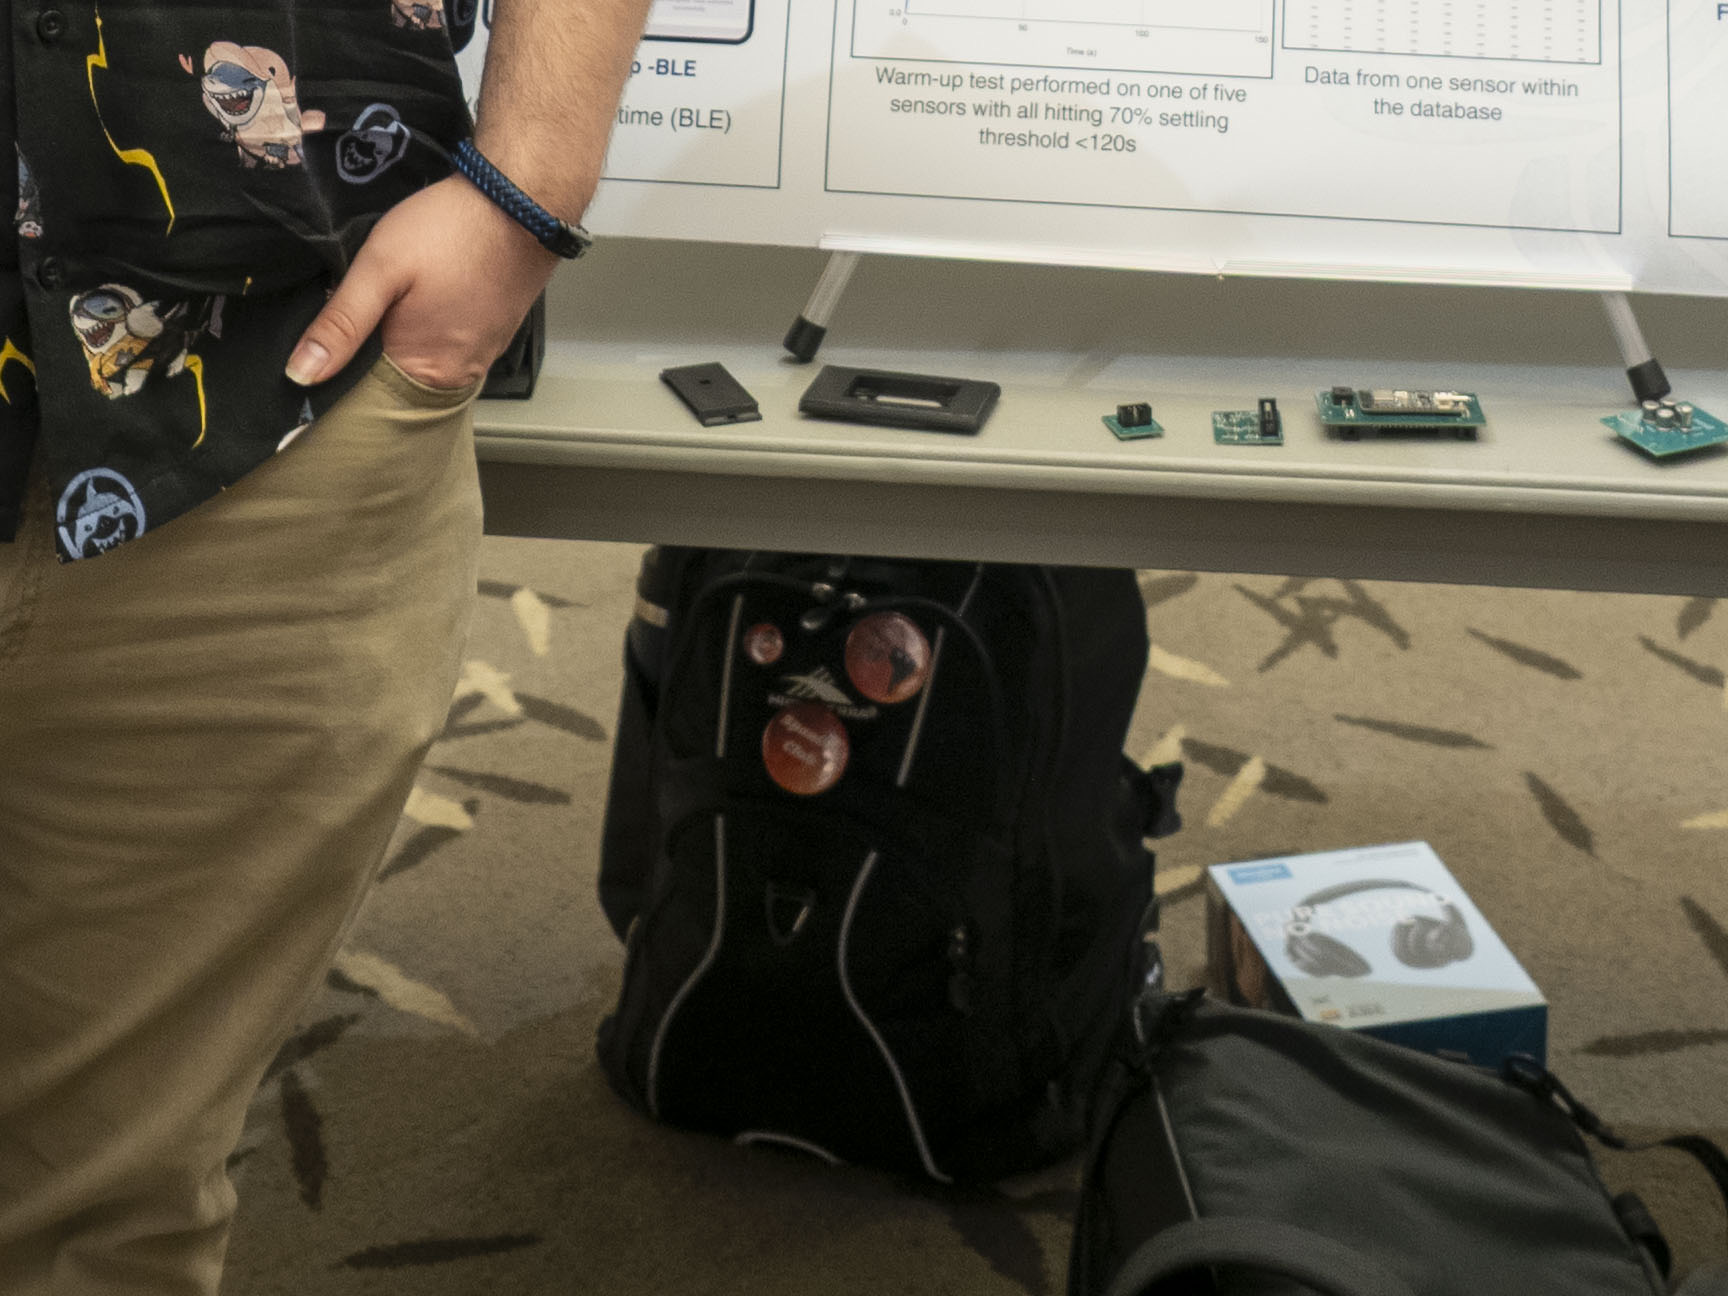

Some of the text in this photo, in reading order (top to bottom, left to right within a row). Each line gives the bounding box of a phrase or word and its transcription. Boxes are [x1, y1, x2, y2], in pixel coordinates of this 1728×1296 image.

[648, 58, 697, 78] -BLE
[1304, 65, 1579, 97] Data from one sensor within
[875, 66, 1248, 103] Warm-up test performed on one of five
[670, 107, 732, 136] (BLE)
[889, 98, 1229, 135] sensors with all hitting 70% settling
[1373, 98, 1503, 122] the database
[978, 127, 1137, 153] threshold <120s
